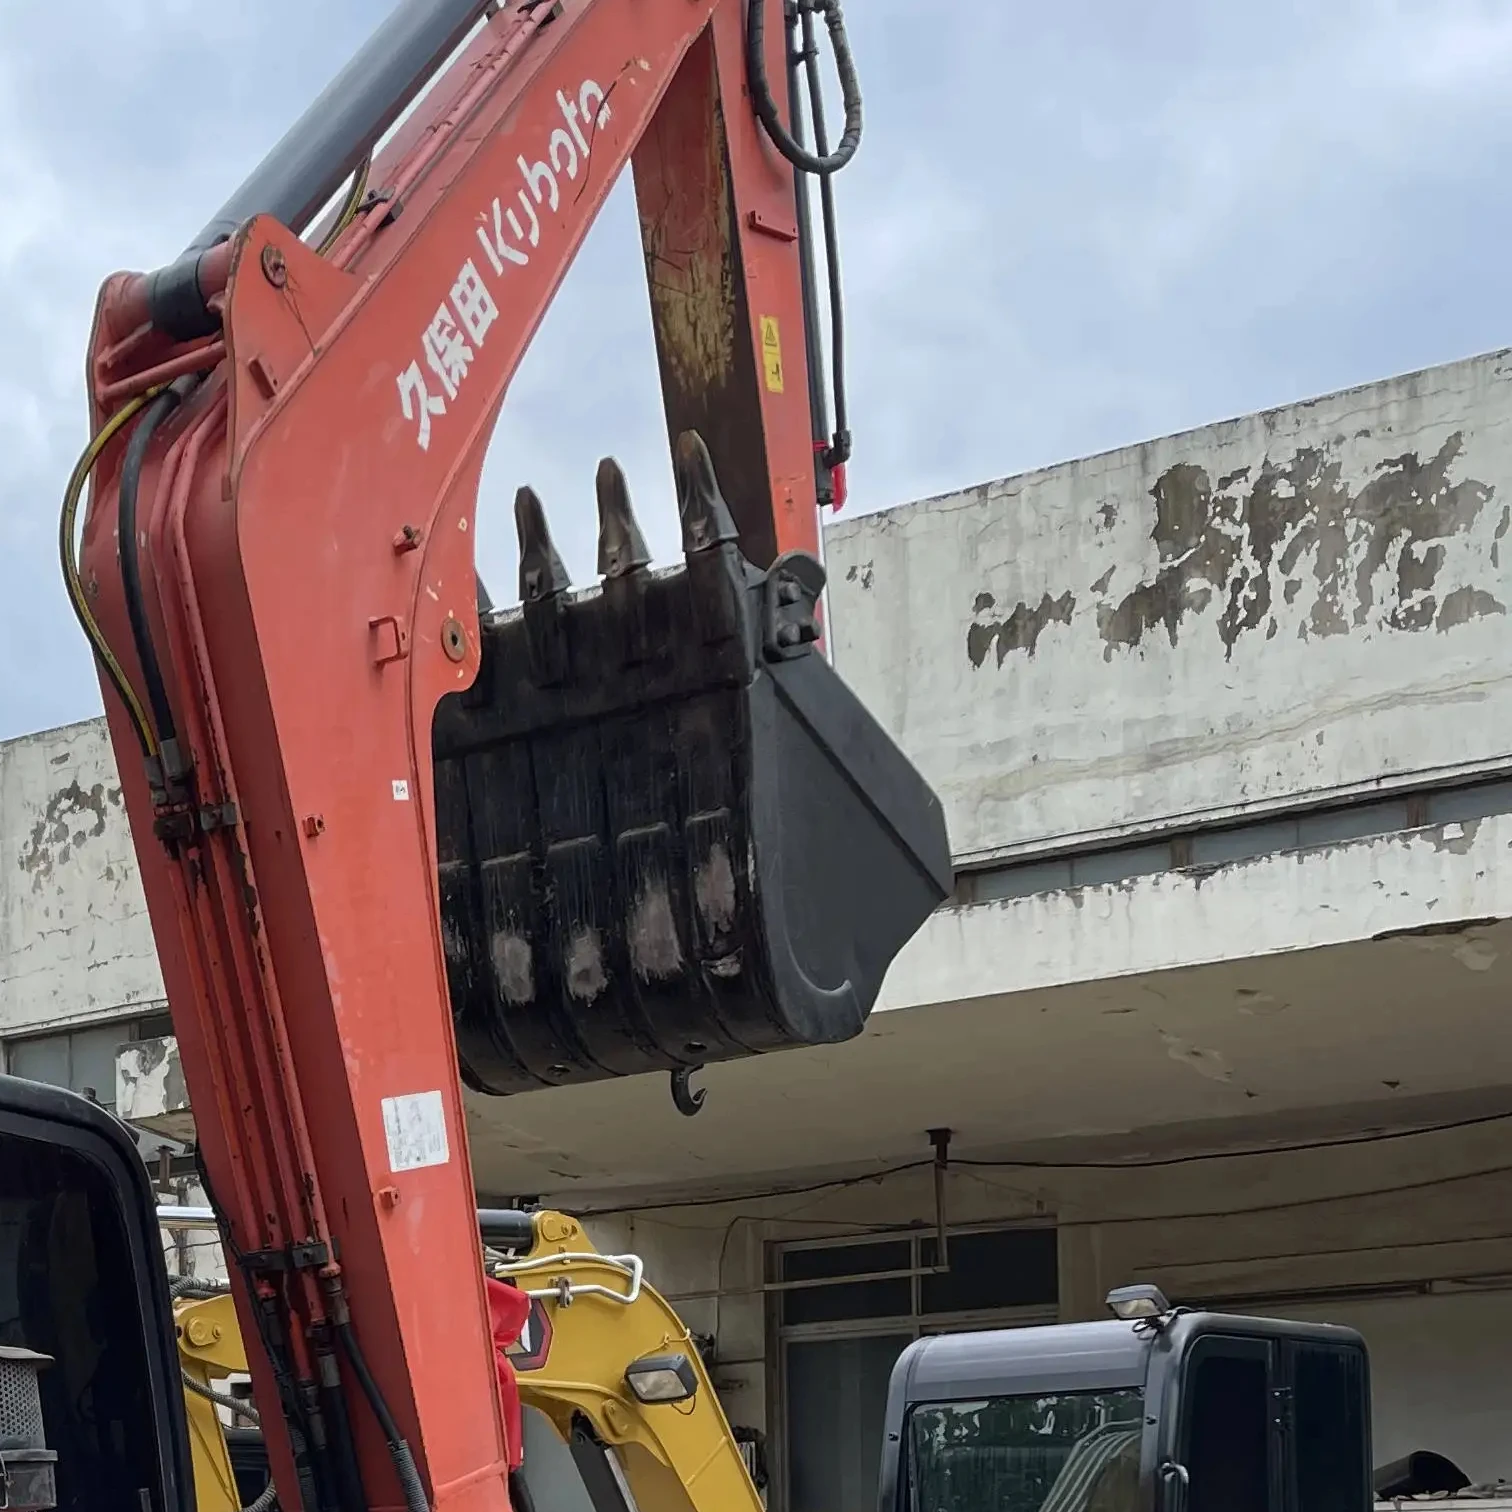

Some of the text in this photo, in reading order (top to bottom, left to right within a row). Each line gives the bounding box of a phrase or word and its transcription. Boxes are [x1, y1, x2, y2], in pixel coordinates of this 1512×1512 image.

[395, 78, 612, 452] 久保田 Kubota
